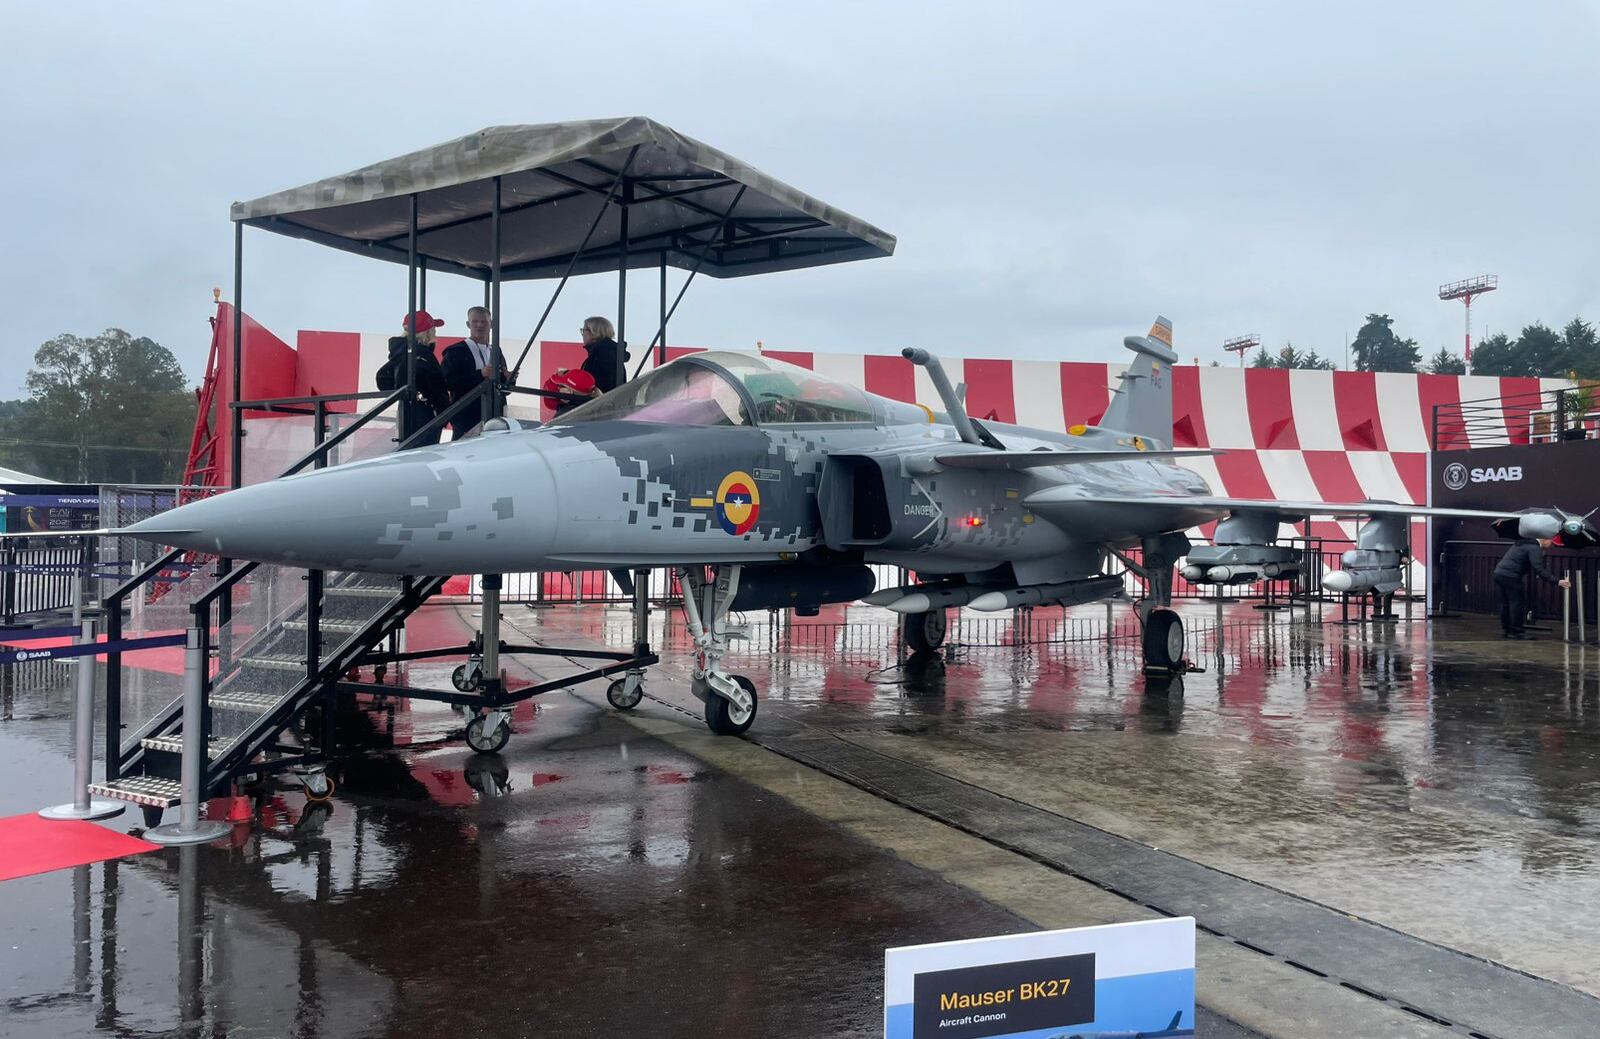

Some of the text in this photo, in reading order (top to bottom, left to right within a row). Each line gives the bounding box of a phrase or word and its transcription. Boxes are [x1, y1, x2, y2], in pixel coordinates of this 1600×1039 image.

[1470, 466, 1523, 483] SAAB
[904, 504, 934, 516] DANGER
[28, 651, 51, 659] SAAB
[940, 978, 1071, 1012] Mauser BK27
[939, 1012, 1007, 1028] Aircraft Cannon
